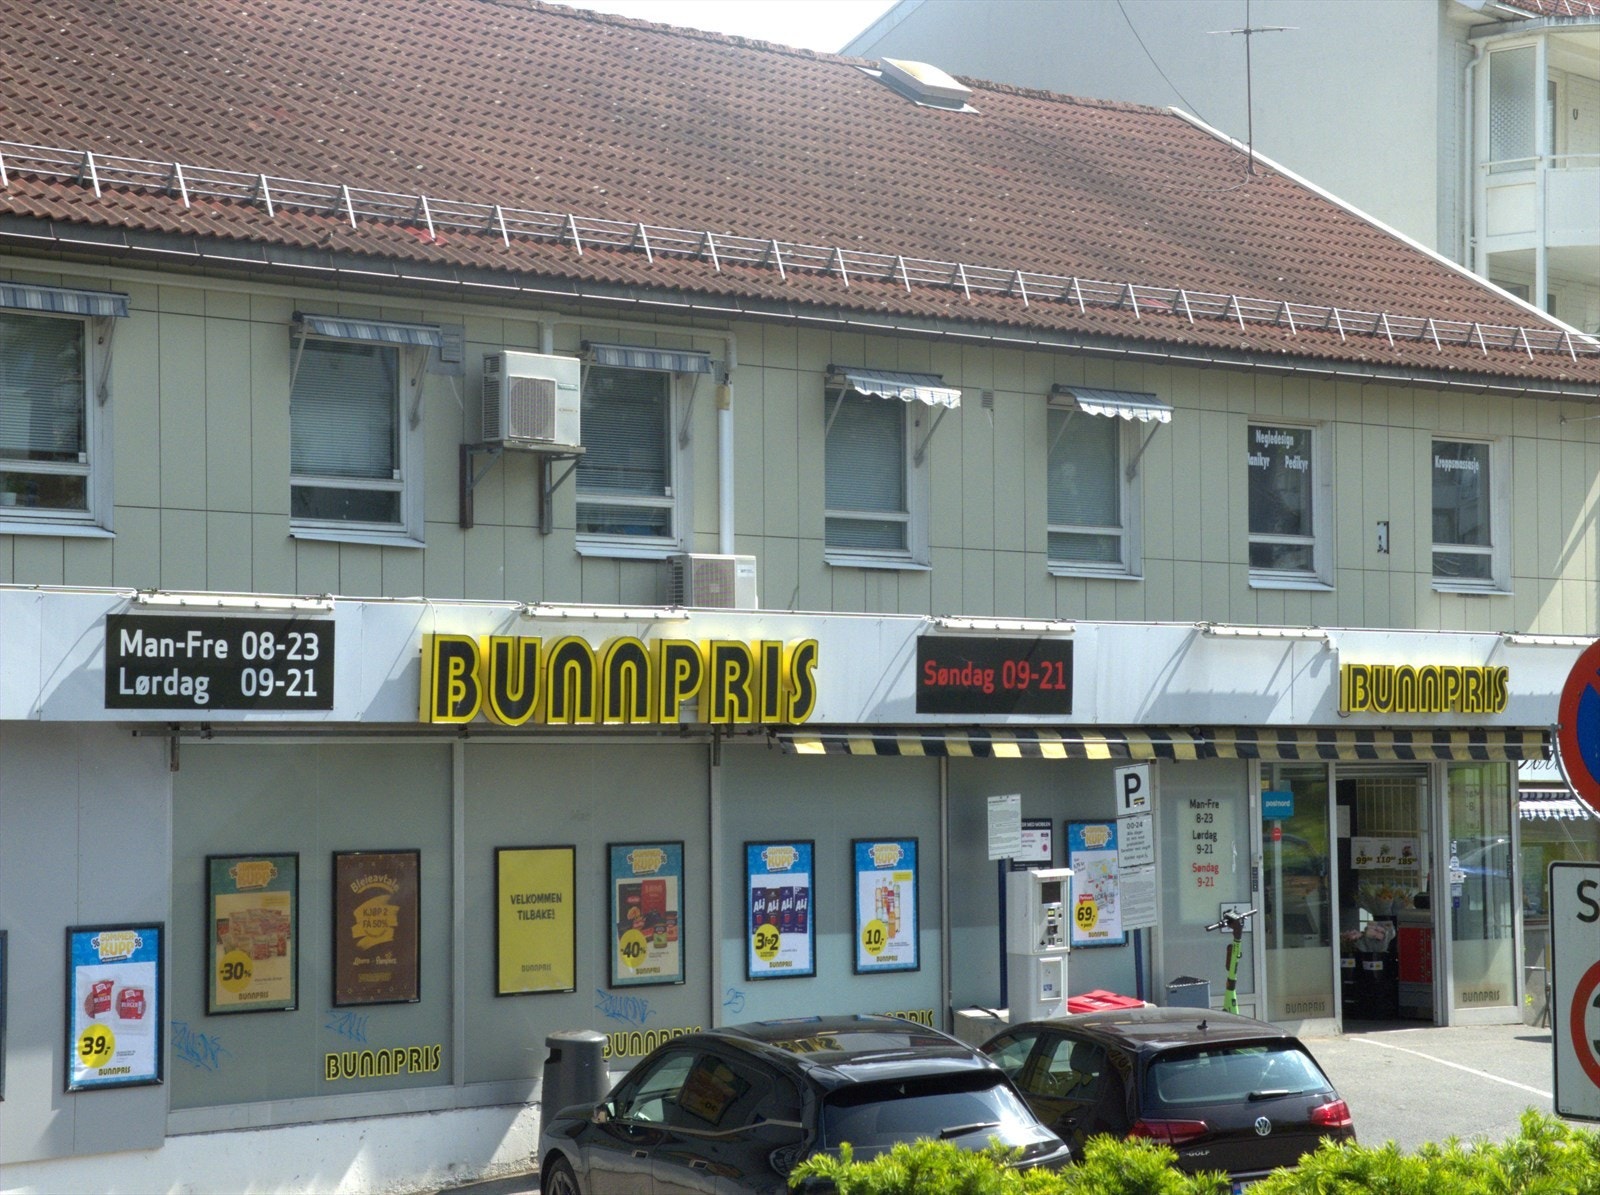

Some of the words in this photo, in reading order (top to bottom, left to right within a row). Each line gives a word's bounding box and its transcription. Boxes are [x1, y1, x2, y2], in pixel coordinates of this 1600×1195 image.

[1255, 429, 1294, 449] Negledesign
[1284, 455, 1309, 473] Pedikyr
[120, 629, 228, 659] Man-Fre
[241, 631, 319, 661] 08-23
[421, 634, 818, 725] BUNNPRIS
[924, 660, 995, 694] Søndag
[1002, 660, 1066, 690] 09-21
[119, 667, 210, 705] Lørdag
[240, 668, 318, 697] 09-21
[1347, 664, 1509, 713] BUNNPRIS
[1124, 773, 1141, 808] P
[1189, 798, 1220, 809] Man-Fre
[1265, 799, 1291, 808] postnord
[1196, 813, 1214, 823] 8-23
[1192, 830, 1217, 843] Lørdag
[1196, 844, 1214, 854] 9-21
[1192, 862, 1219, 875] Søndag
[1197, 876, 1215, 887] 9-21
[510, 893, 562, 905] VELKOMMEN
[517, 909, 555, 921] TILBAKE!
[99, 941, 135, 957] KUPP
[219, 962, 252, 981] -30%
[1462, 989, 1500, 1002] BUNNPRIS
[1285, 1001, 1326, 1014] BUNNPRIS
[325, 1044, 441, 1081] BUNNPRIS
[98, 1066, 131, 1076] BUNNPRIS
